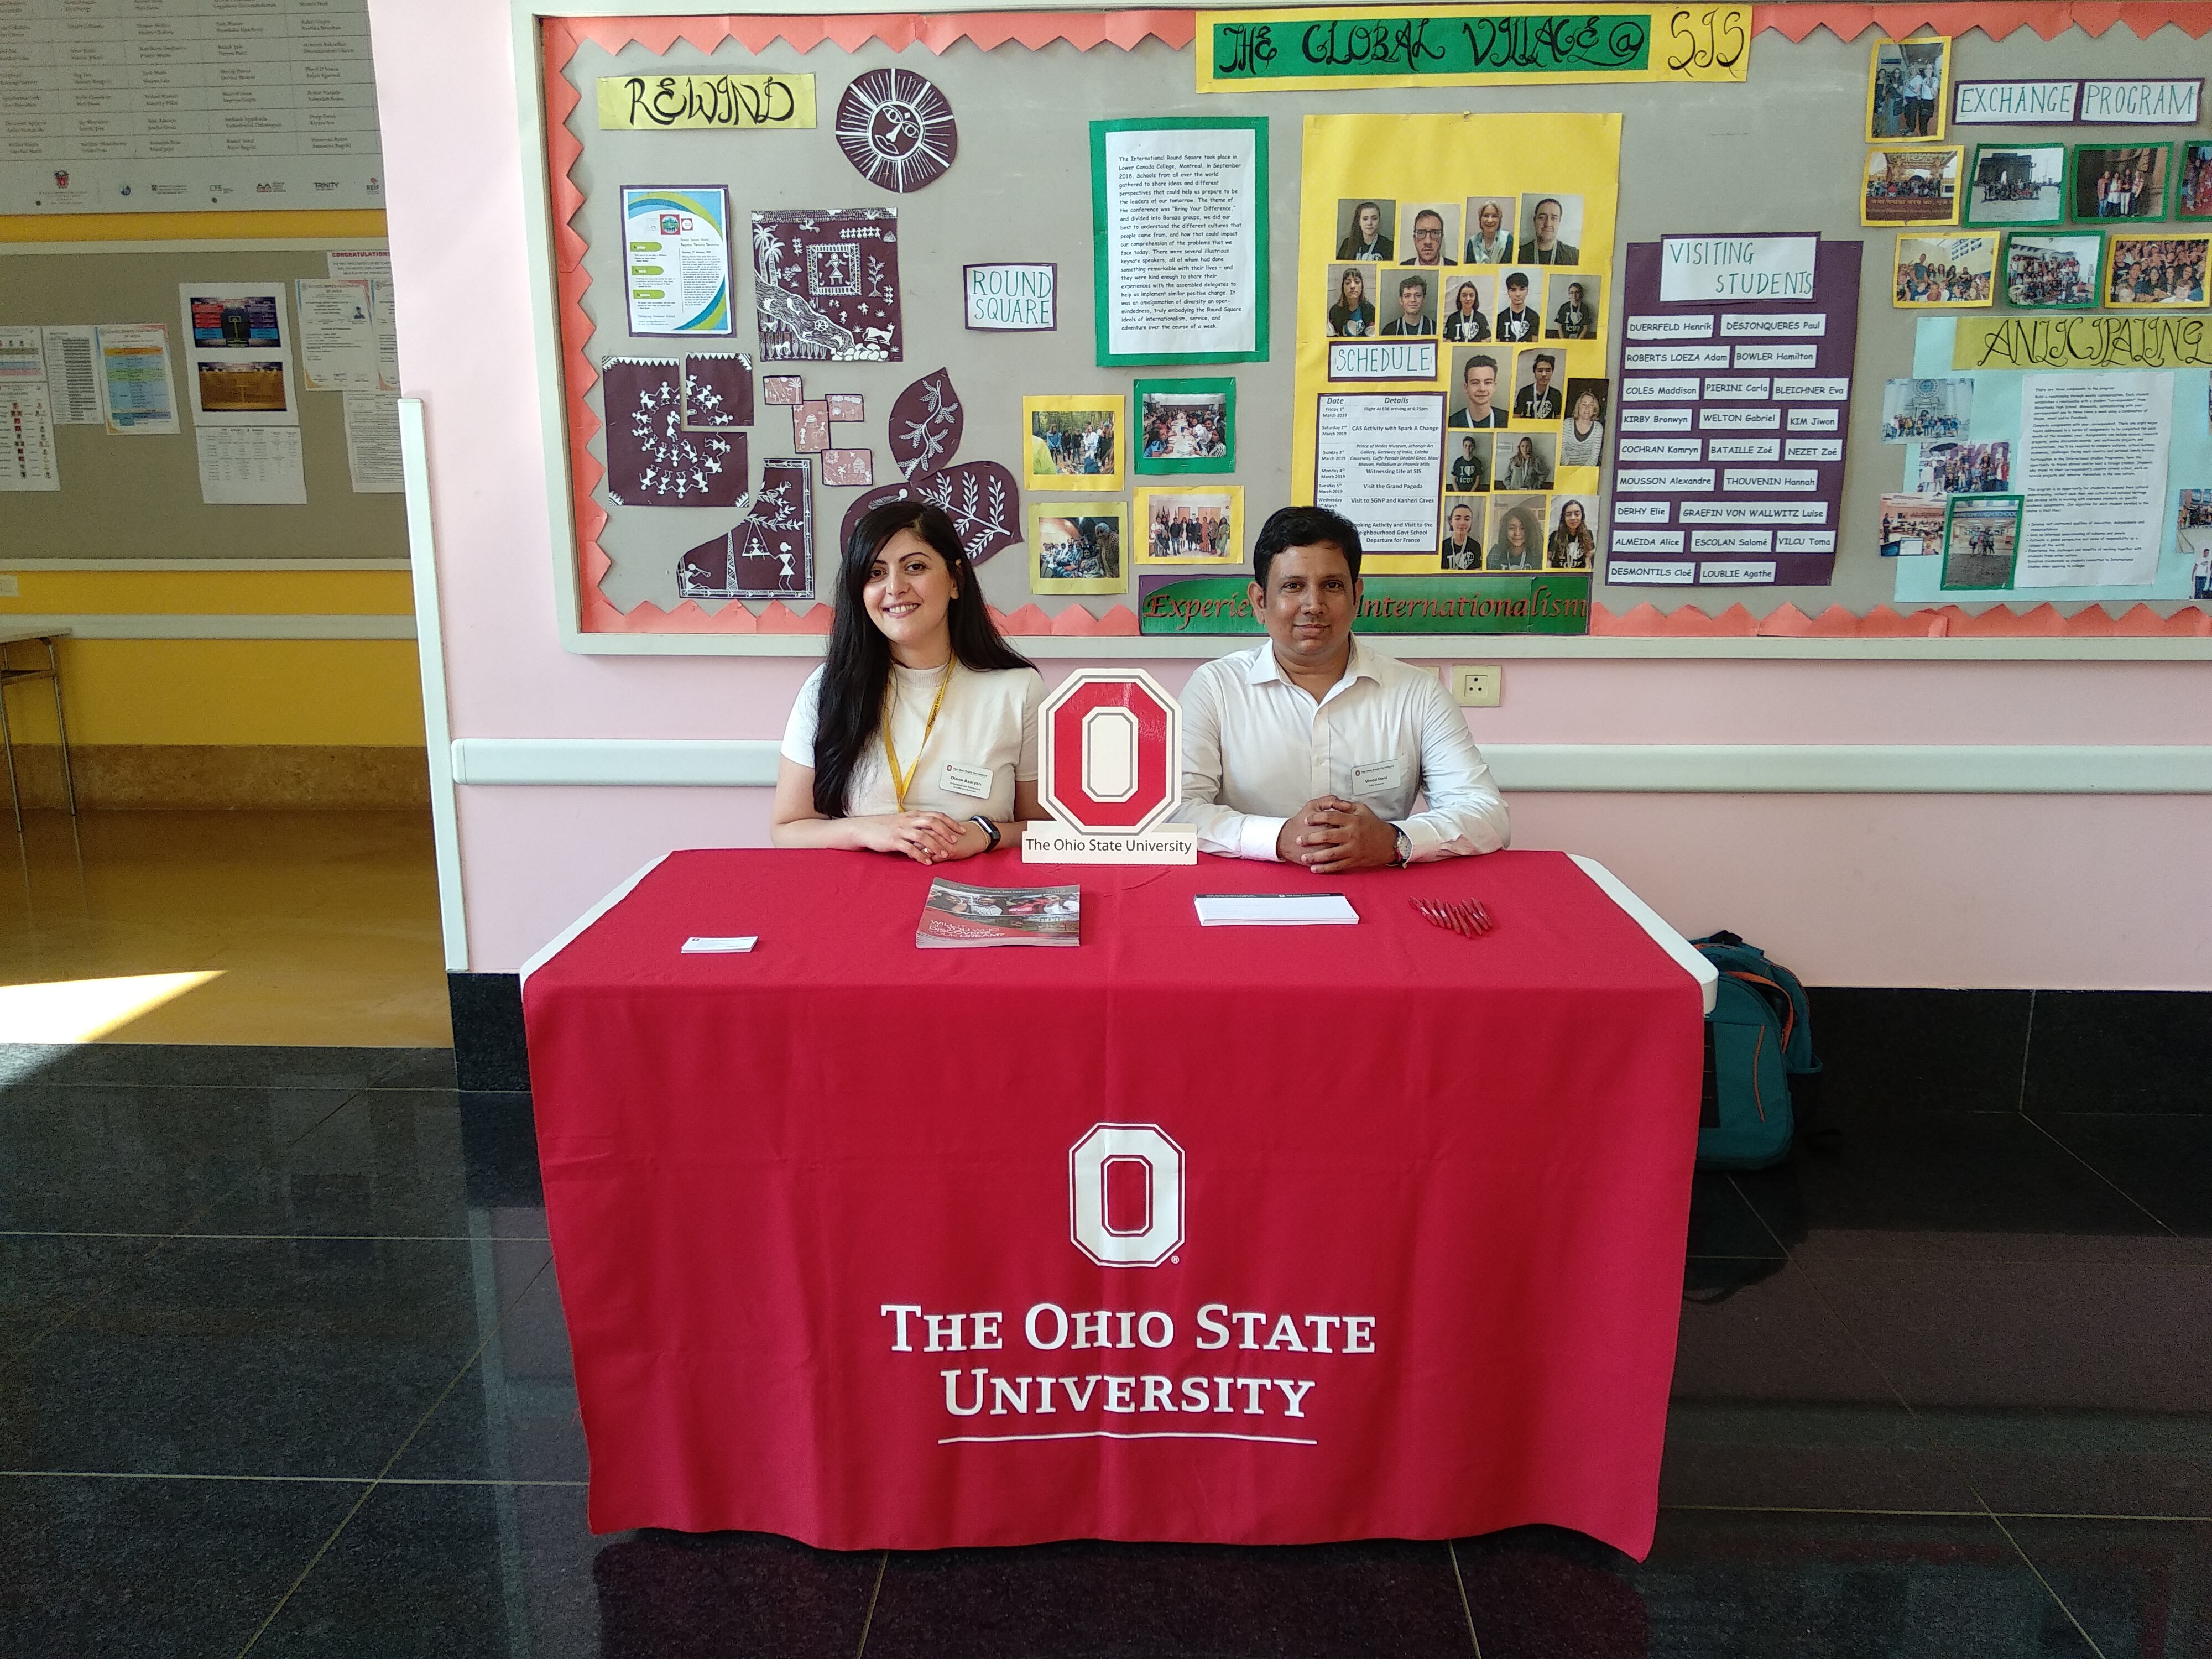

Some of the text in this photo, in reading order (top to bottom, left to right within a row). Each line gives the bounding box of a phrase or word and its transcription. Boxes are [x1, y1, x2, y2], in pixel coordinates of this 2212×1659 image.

[1219, 24, 1277, 75] THE
[1302, 18, 1446, 72] GLOBAL
[1463, 16, 1600, 67] VILLAGE
[1608, 21, 1645, 60] @
[624, 76, 795, 126] REWIND
[1961, 85, 2194, 115] EXCHANGE PROGRAM
[1670, 242, 1755, 265] VISITING
[973, 270, 1052, 296] ROUND
[1715, 271, 1812, 295] STUDENTS
[974, 298, 1051, 325] SQUARE
[1630, 322, 1712, 331] DUERRFELD Henrik
[1726, 321, 1820, 331] DESJONQUERES Paul
[1336, 347, 1430, 372] SCHEDULE
[1627, 353, 1728, 362] ROBERTS LOEZA Adam
[1736, 352, 1813, 361] BOWLER Hamilton
[1626, 386, 1697, 395] COLES Maddison
[1706, 384, 1768, 392] PIERINI Carla
[1775, 386, 1844, 394] BLEICHNER Eva
[1653, 415, 1688, 425] Bronwyn
[1703, 414, 1776, 422] WELTON Gabriel
[1667, 446, 1698, 456] Kamryn
[1711, 446, 1773, 454] BATAILLE Zoé
[1788, 447, 1837, 456] NEZET Zoé
[1725, 477, 1781, 486] THOUVENIN
[1618, 507, 1665, 515] DERHY Elie
[1615, 538, 1656, 546] ALMEIDA
[1695, 538, 1736, 546] ESCOLAN
[1611, 567, 1692, 577] DESMONTILS Cloé
[1702, 570, 1772, 580] LOUBLIE Agathe
[1143, 592, 1256, 630] Experie
[928, 704, 939, 728] Singapore
[1038, 668, 1182, 836] O
[1026, 839, 1192, 854] The Ohio State University
[1069, 1121, 1186, 1267] O
